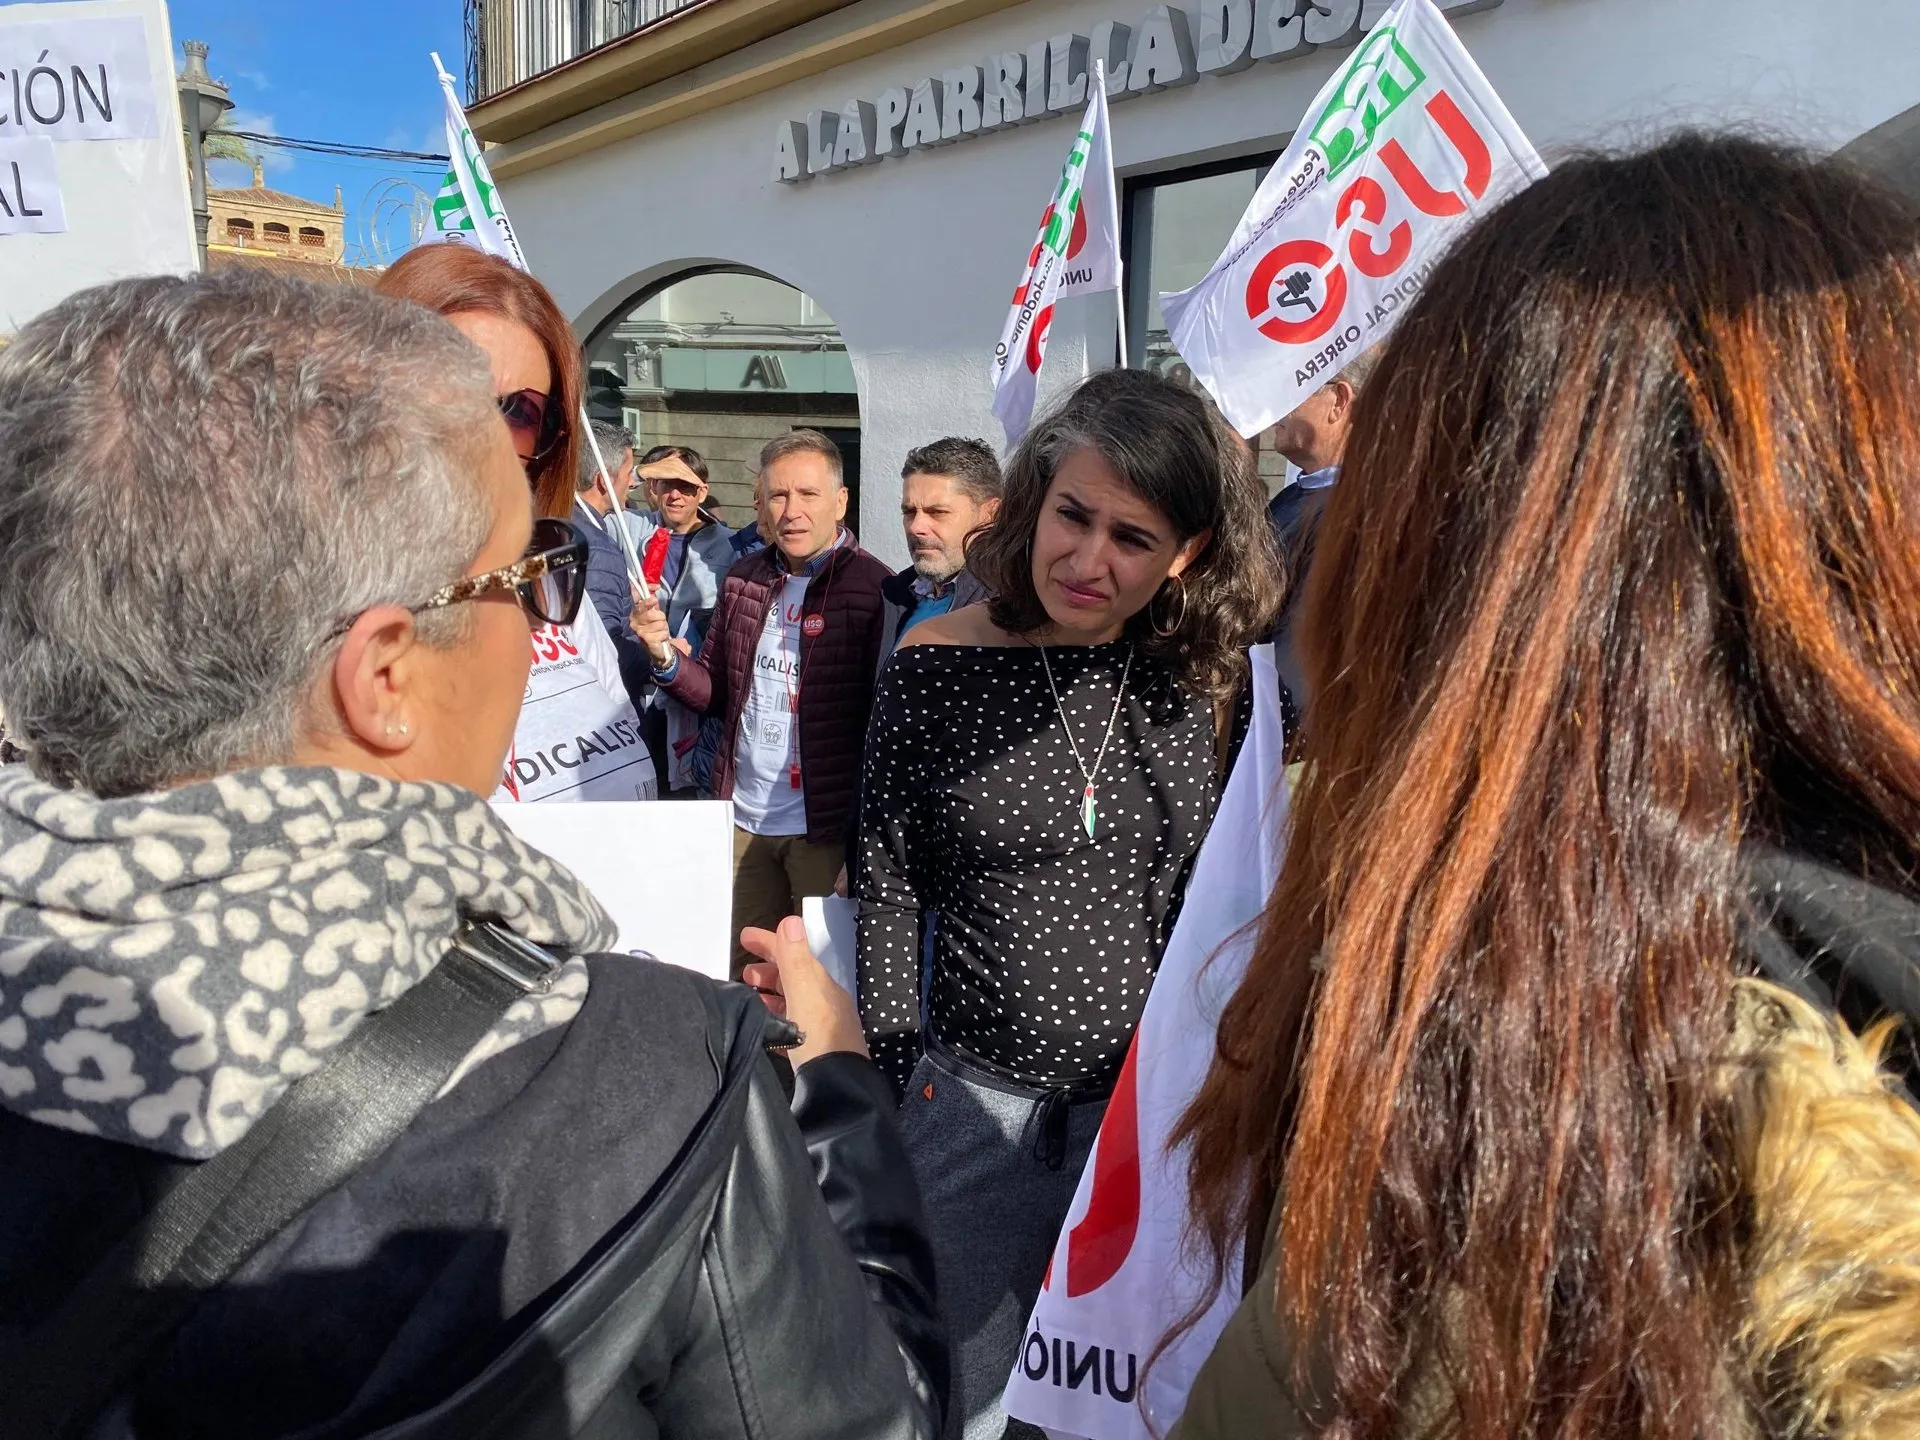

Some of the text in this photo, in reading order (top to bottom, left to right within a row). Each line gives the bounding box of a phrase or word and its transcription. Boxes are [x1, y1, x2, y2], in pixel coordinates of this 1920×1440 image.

[772, 0, 1388, 184] A LA PARRILLA DES
